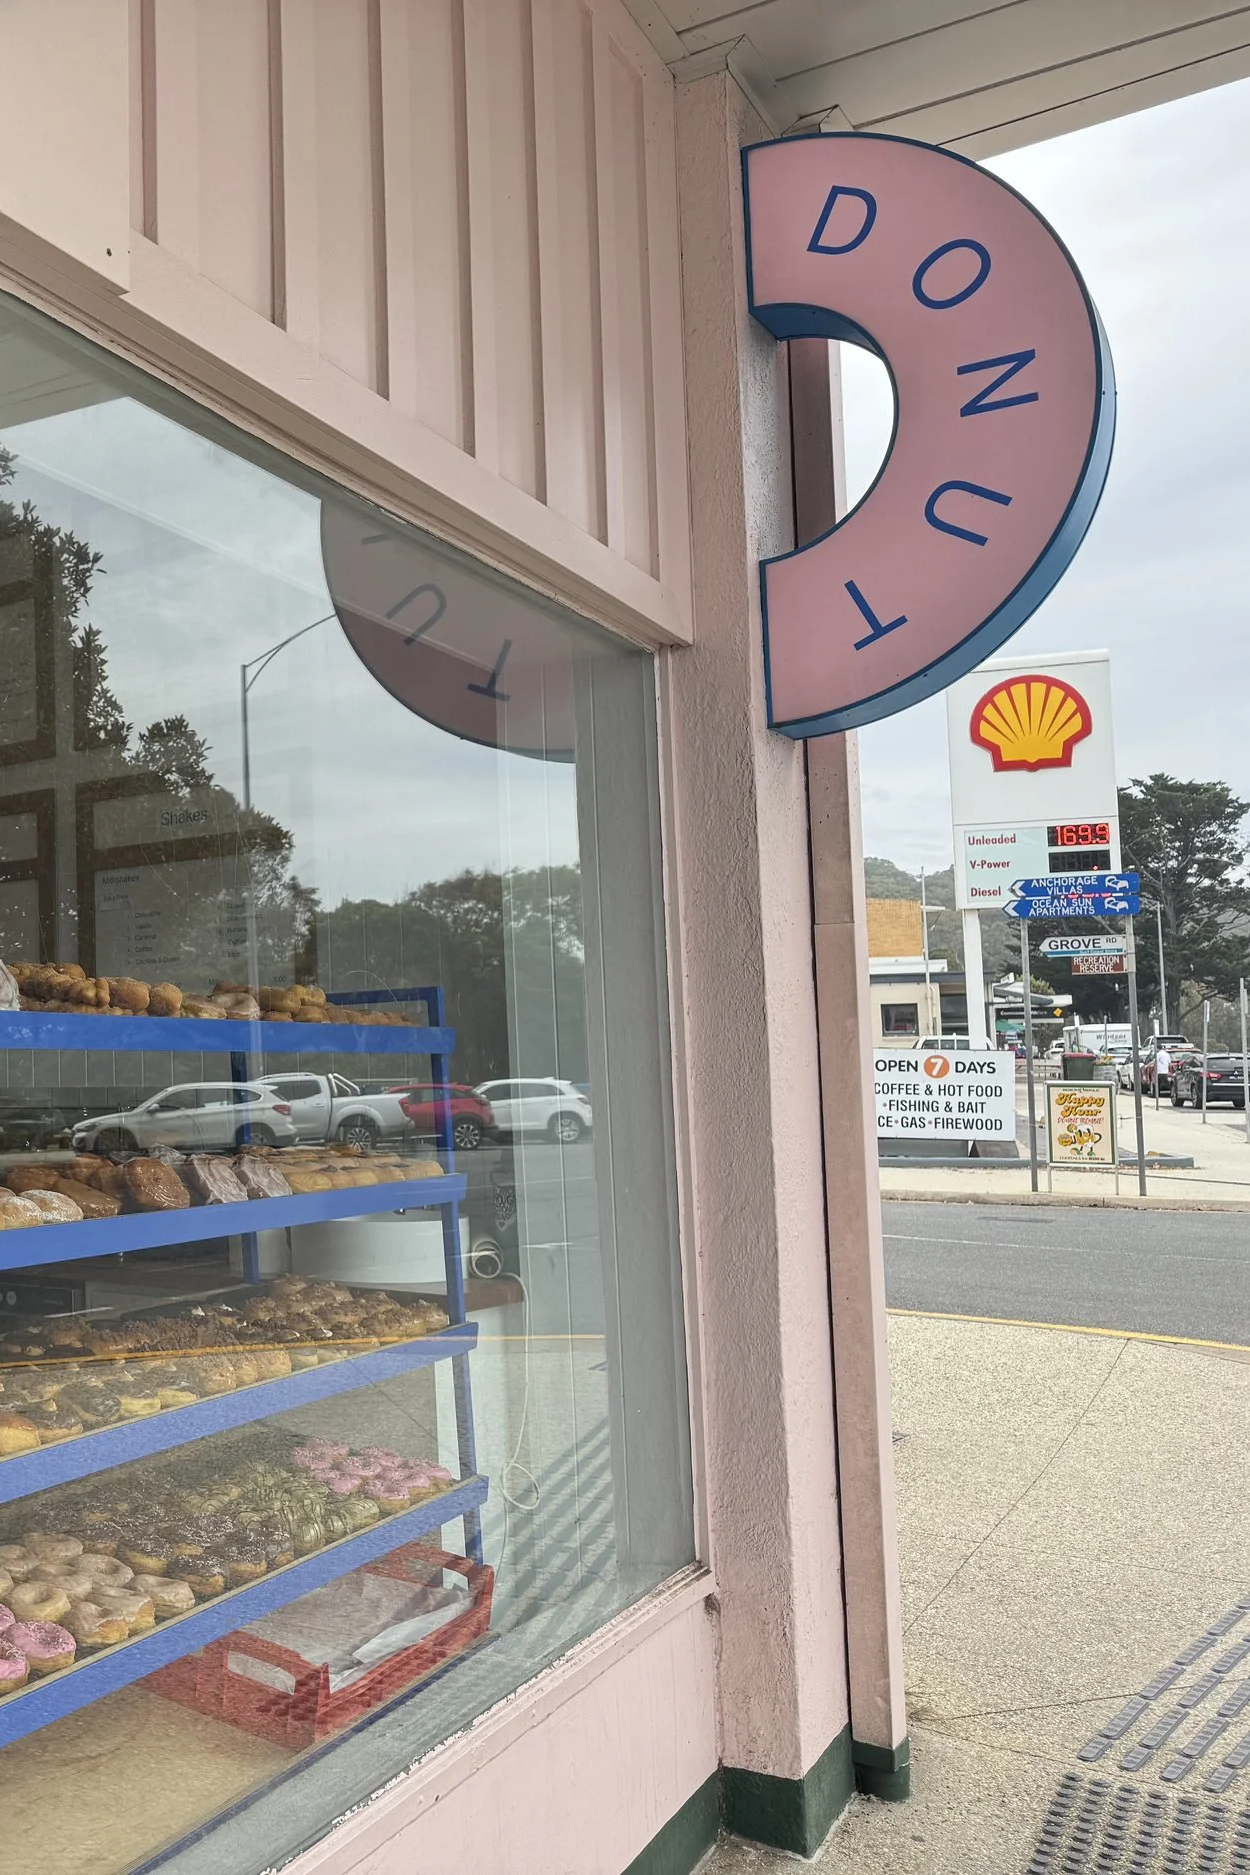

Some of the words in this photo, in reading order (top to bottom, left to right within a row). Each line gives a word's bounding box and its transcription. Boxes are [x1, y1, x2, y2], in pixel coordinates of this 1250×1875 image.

[806, 184, 1039, 652] DONUT
[161, 809, 208, 826] Shakes
[968, 833, 1017, 846] Unleaded
[1056, 823, 1110, 846] 169.9
[970, 860, 1010, 869] V-Power
[1031, 875, 1098, 888] ANCHORAGE
[970, 886, 1002, 897] Diesel
[1047, 885, 1084, 896] VILLAS
[1032, 898, 1068, 908] OCEAN
[1072, 898, 1092, 906] SUN
[1028, 906, 1095, 916] APARTMENTS
[1048, 938, 1102, 950] GROVE
[1074, 956, 1120, 965] RECREATION
[1079, 964, 1114, 973] RESERVE
[875, 1060, 918, 1072] OPEN
[930, 1058, 944, 1076] 7
[955, 1061, 996, 1074] DAYS
[875, 1082, 920, 1096] COFFEE
[924, 1084, 934, 1096] &
[938, 1084, 964, 1097] HOT
[968, 1085, 1003, 1098] FOOD
[1056, 1092, 1105, 1108] Happy
[944, 1102, 953, 1113] &
[958, 1102, 986, 1114] BAIT
[1061, 1105, 1102, 1117] Hour
[877, 1116, 893, 1128] CE
